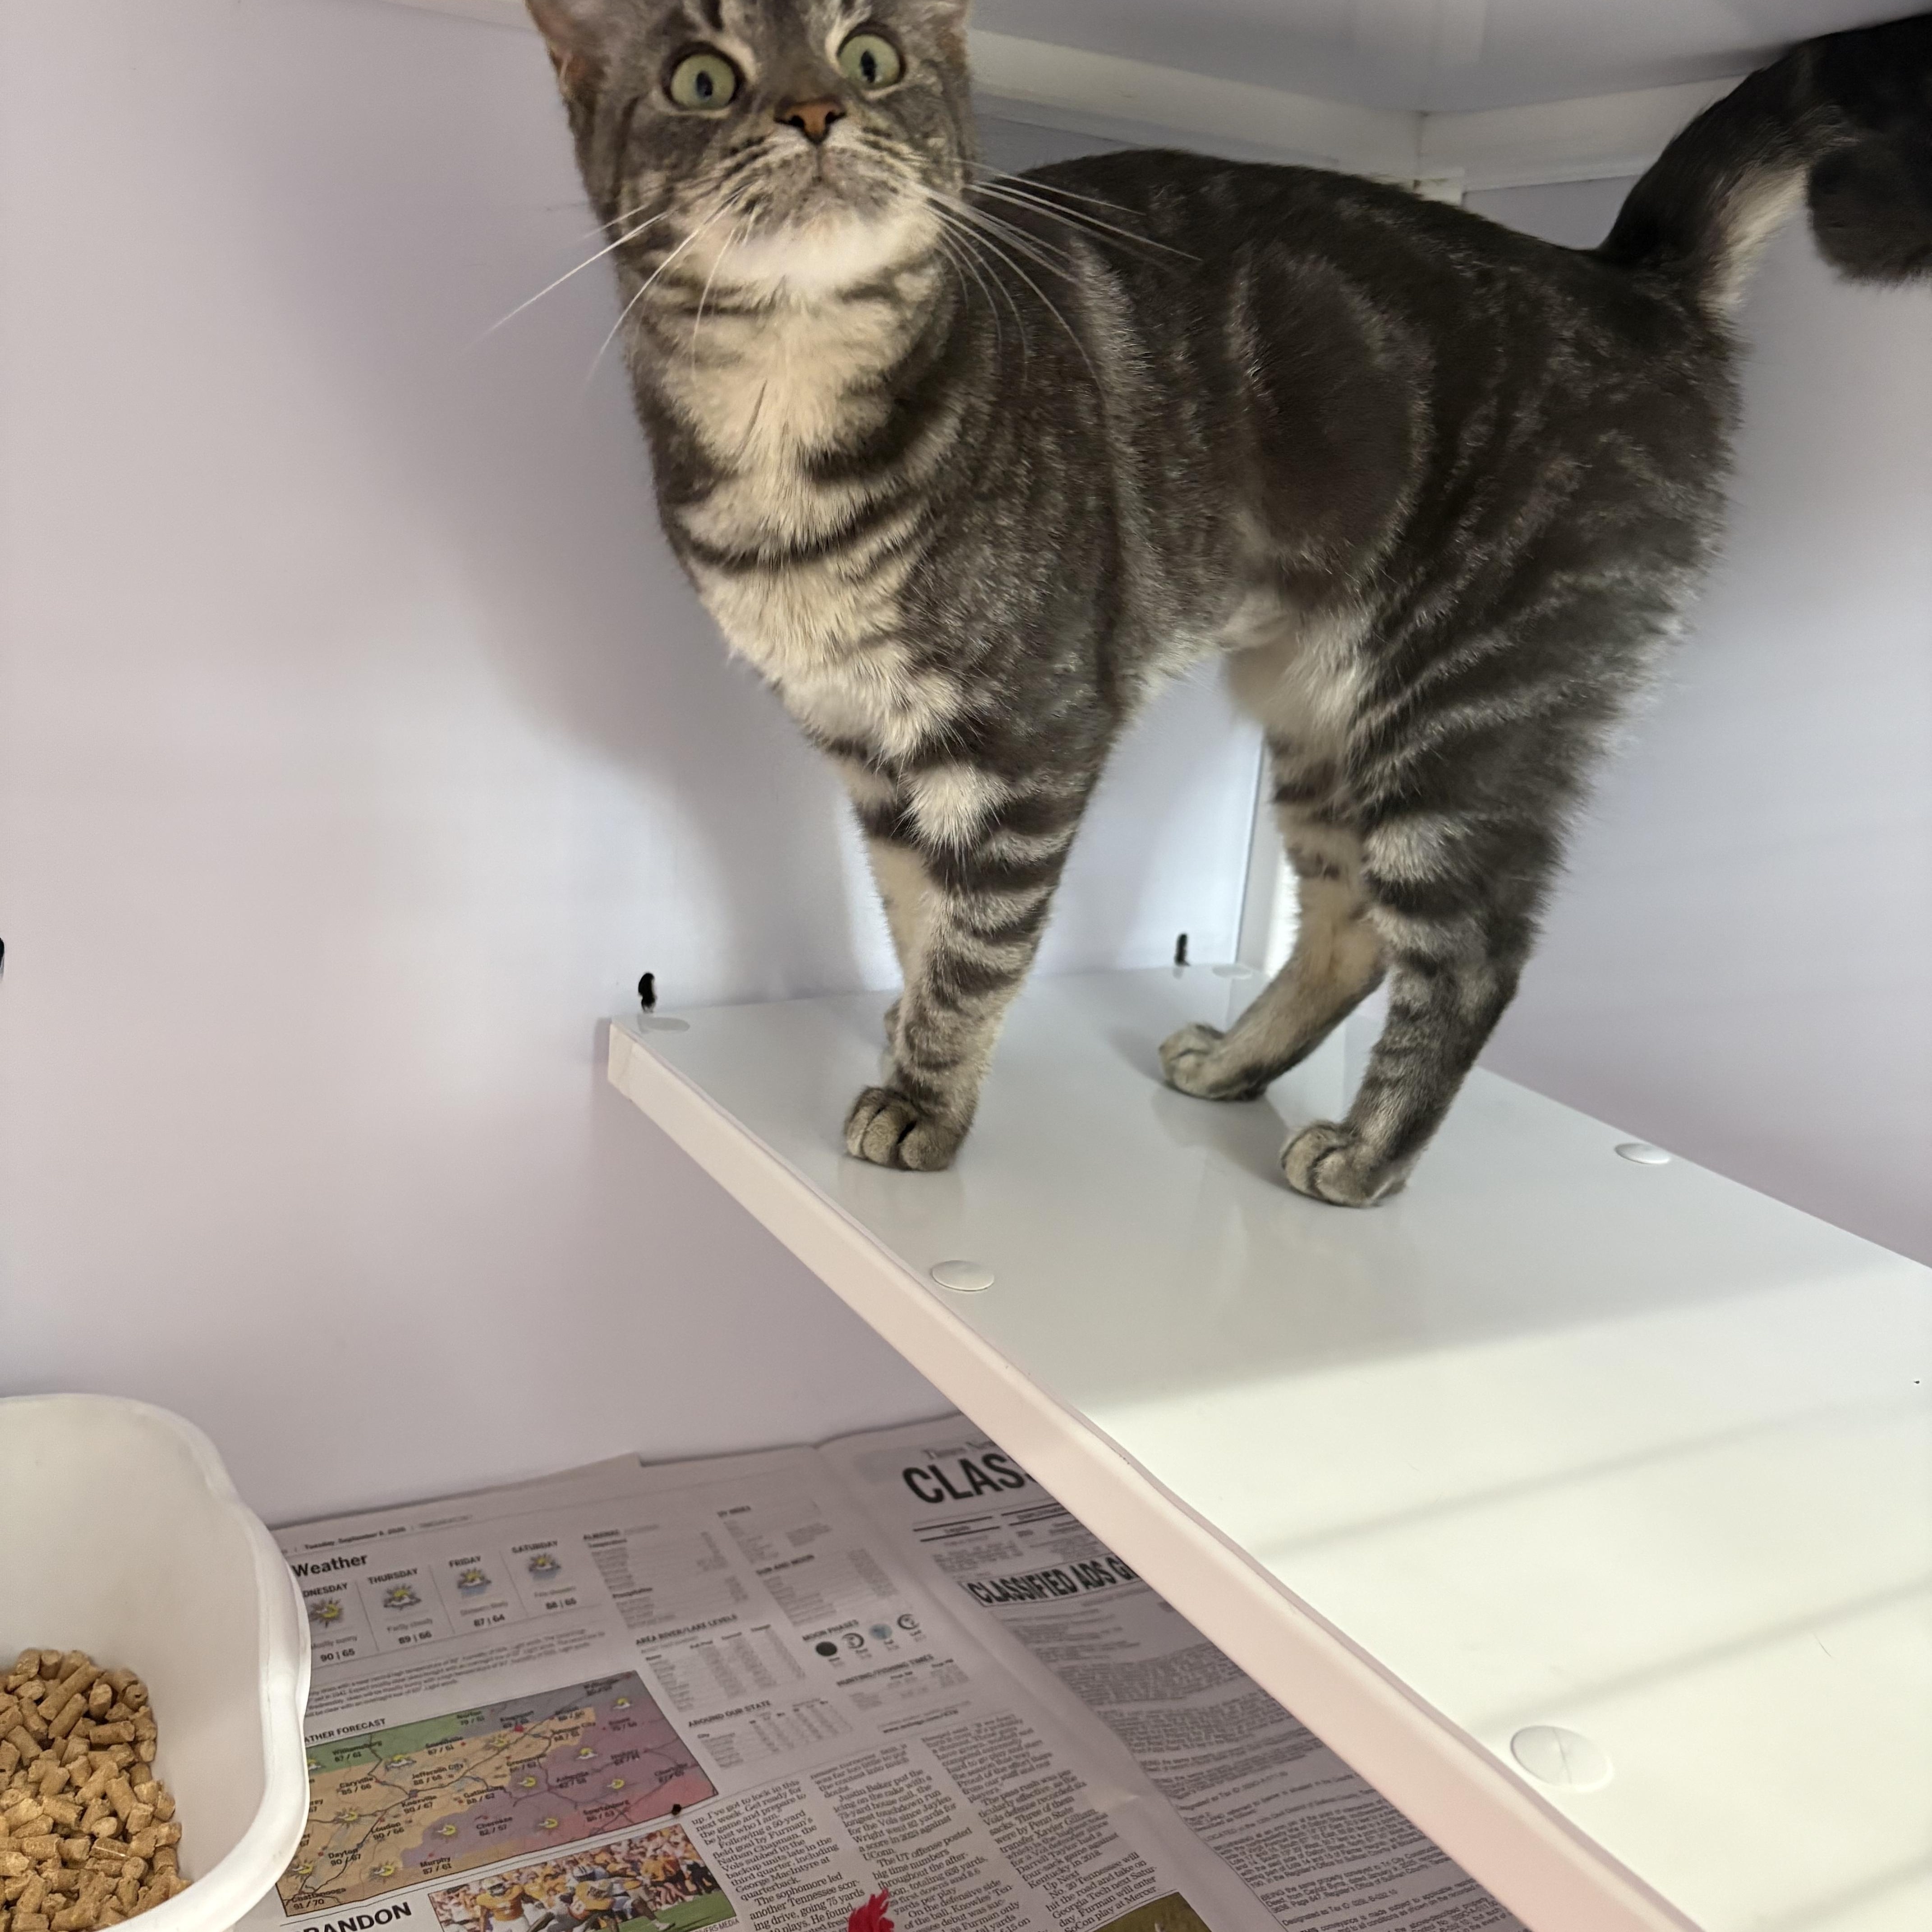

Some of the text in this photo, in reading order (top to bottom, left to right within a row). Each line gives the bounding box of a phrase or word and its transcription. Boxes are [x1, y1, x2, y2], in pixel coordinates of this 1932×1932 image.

[903, 1454, 1034, 1503] CLAS
[511, 1541, 558, 1553] SATURDAY
[292, 1555, 367, 1577] Weather
[449, 1556, 481, 1567] FRIDAY
[367, 1568, 418, 1584] THURSDAY
[967, 1569, 1078, 1603] CLASSIFIED
[1069, 1560, 1116, 1589] ADS
[303, 1582, 347, 1597] DNESDAY
[636, 1635, 656, 1645] AREA
[803, 1630, 827, 1642] MOON
[320, 1648, 355, 1662] 90 65
[689, 1700, 771, 1727] AROUND OUR STATE
[304, 1718, 386, 1743] ATHER FORECAST
[332, 1740, 382, 1755] Williamsburg
[412, 1762, 464, 1780] Jefferson City
[339, 1777, 373, 1789] Caryville
[401, 1795, 437, 1808] Knoxville
[372, 1822, 401, 1834] Loudon
[476, 1816, 513, 1830] Cherokee
[328, 1848, 358, 1859] Dayton
[877, 1827, 972, 1867] The UT offense posted
[420, 1856, 451, 1868] Murphy
[726, 1865, 761, 1879] backup
[762, 1856, 787, 1866] units
[787, 1849, 805, 1858] late
[817, 1838, 831, 1846] the
[731, 1873, 755, 1886] third
[796, 1845, 839, 1863] including
[872, 1849, 951, 1880] big time numbers
[878, 1868, 929, 1891] throughout
[929, 1863, 944, 1872] the
[909, 1873, 945, 1890] totaling
[1027, 1866, 1074, 1889] Kentucky
[1068, 1859, 1082, 1868] in
[1043, 1871, 1081, 1890] Up Next
[1066, 1882, 1077, 1890] 20
[1076, 1862, 1122, 1884] Tennessee
[1122, 1852, 1139, 1863] will
[736, 1876, 769, 1892] George
[741, 1877, 800, 1901] quarterback.
[754, 1872, 842, 1905] The sophomore led
[1045, 1901, 1060, 1911] hit
[1060, 1894, 1075, 1904] the
[1076, 1881, 1097, 1896] road
[1098, 1873, 1115, 1886] and
[1114, 1866, 1133, 1877] take
[1052, 1867, 1156, 1918] Georgia Tech next Satur-
[292, 1888, 346, 1903] Chattanooga
[750, 1881, 859, 1920] another Tennessee scor-
[893, 1901, 920, 1915] yards
[921, 1895, 935, 1905] per
[924, 1904, 938, 1912] the
[940, 1888, 981, 1907] defensive
[983, 1881, 1001, 1891] side
[1078, 1895, 1116, 1917] Furman
[1116, 1885, 1134, 1897] will
[1134, 1877, 1156, 1889] enter
[295, 1902, 412, 1932] ANDON
[754, 1889, 865, 1931] ing drive, going 75 yards
[810, 1914, 824, 1924] He
[826, 1903, 854, 1919] found
[942, 1909, 966, 1926] debut
[968, 1907, 986, 1917] was
[961, 1902, 1019, 1930] Furman only
[1065, 1918, 1095, 1932] SoCon
[1095, 1906, 1113, 1921] play
[1124, 1886, 1156, 1904] Mercer
[719, 1918, 740, 1929] MEDIA
[905, 1921, 914, 1929] of
[915, 1917, 930, 1925] the
